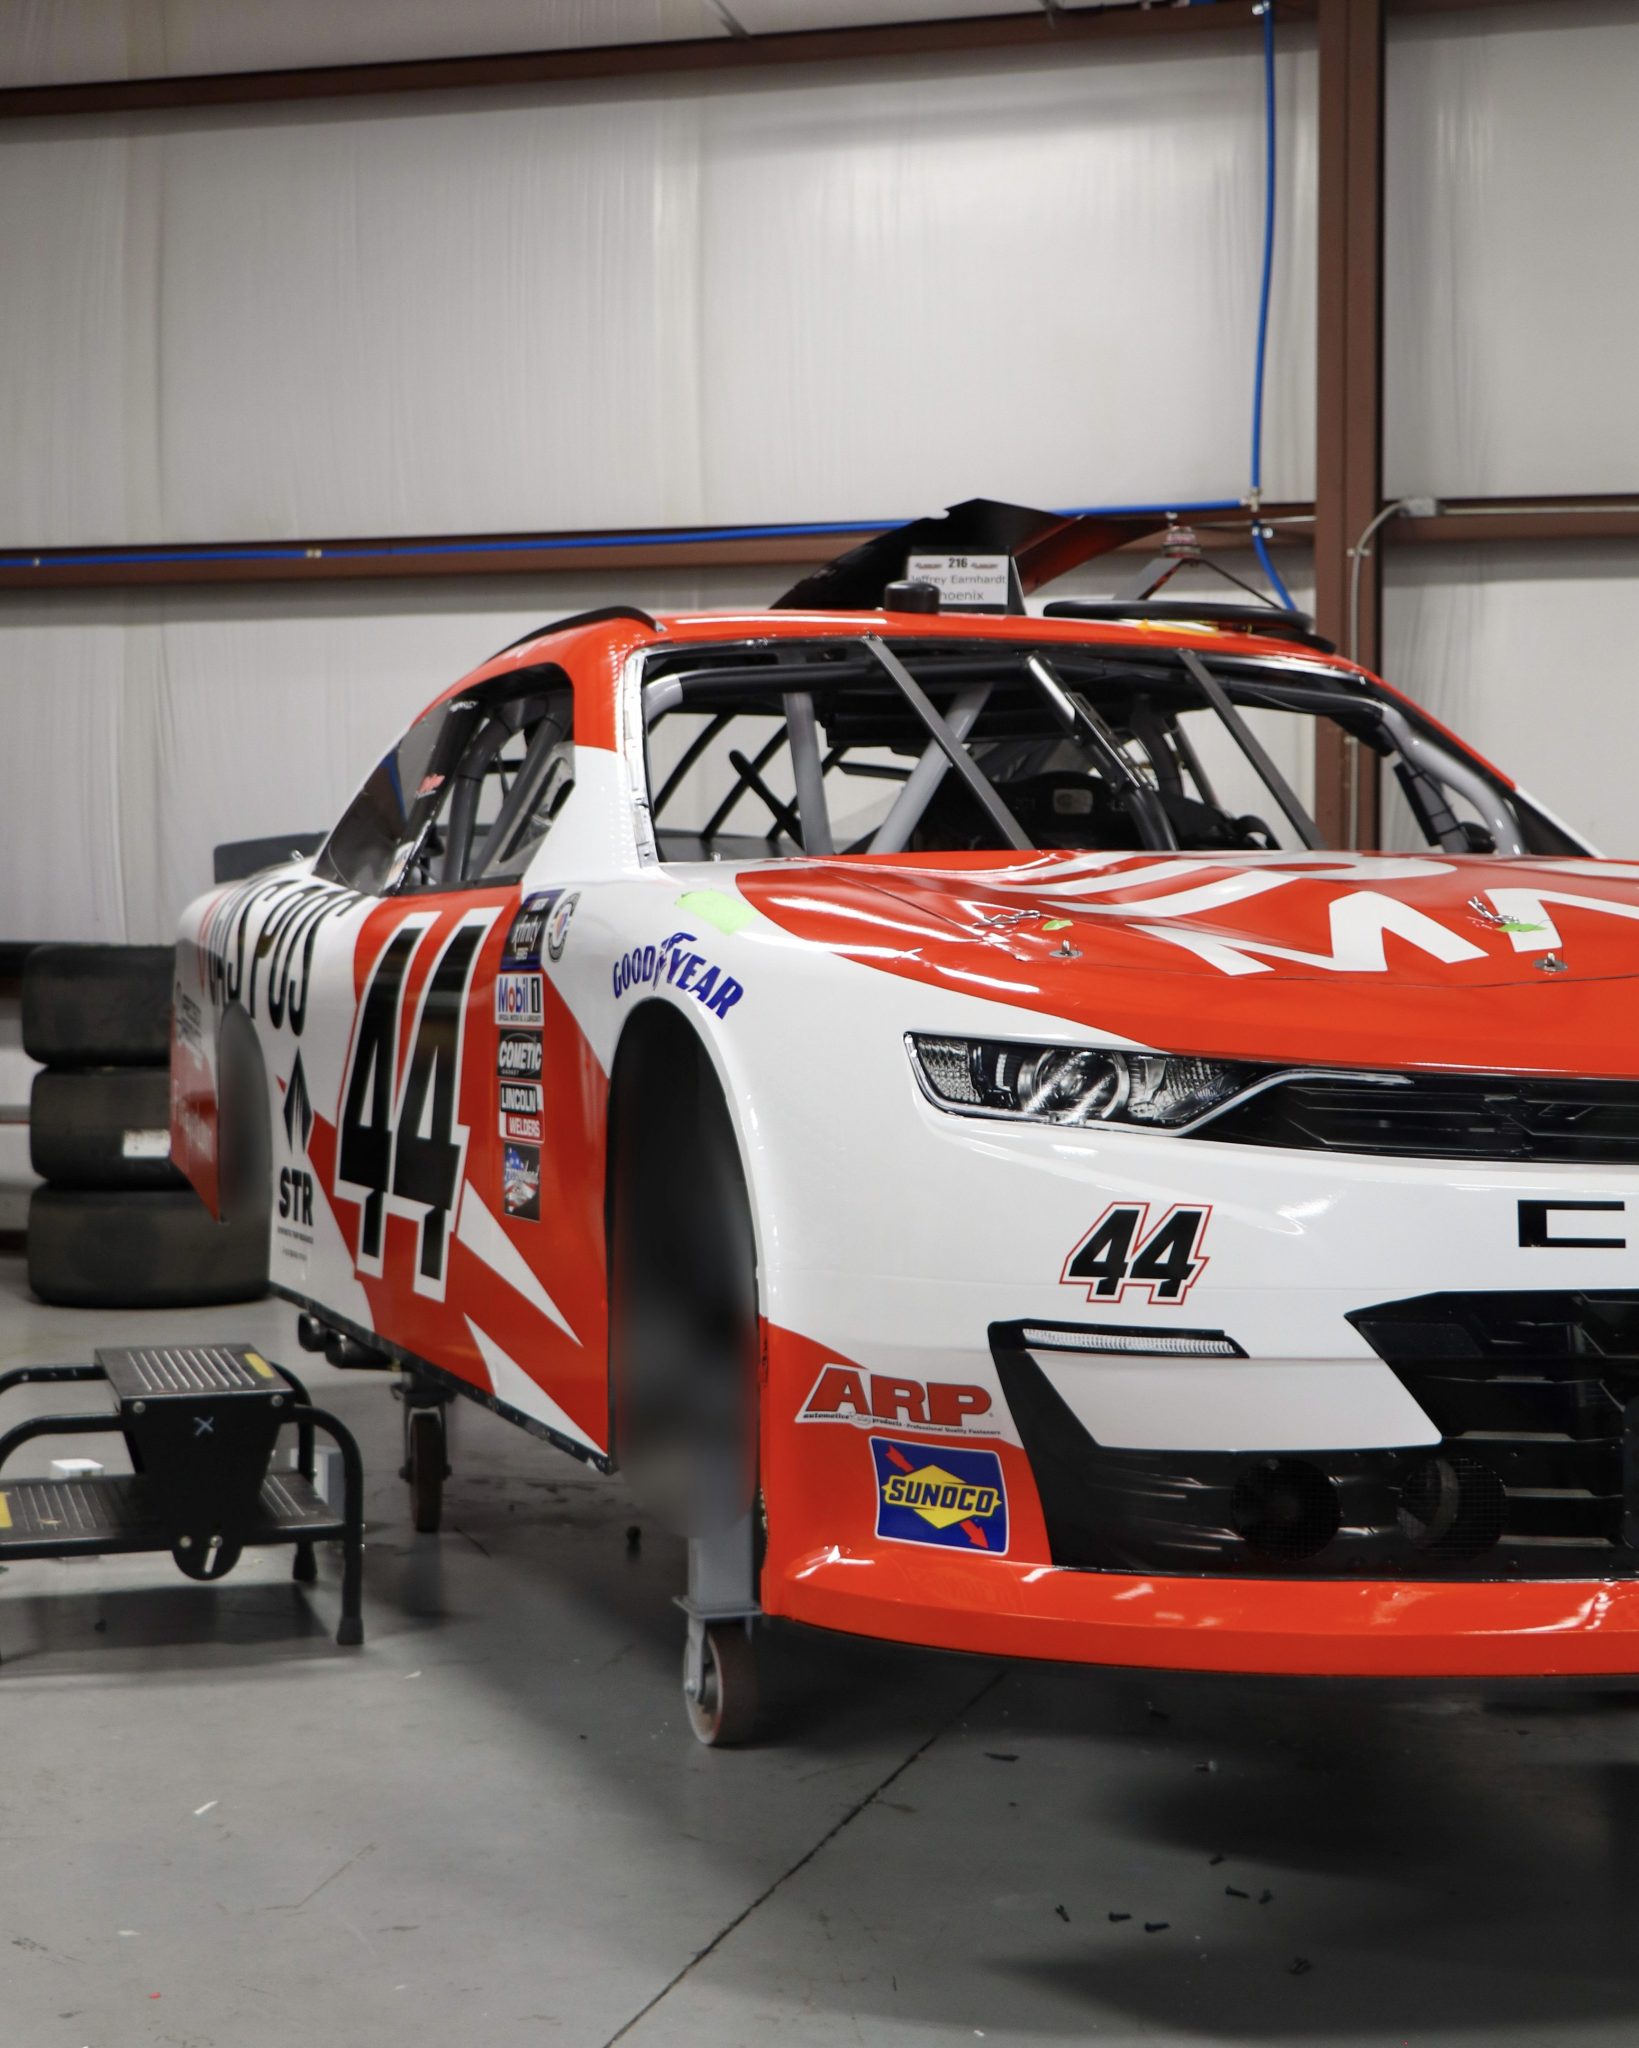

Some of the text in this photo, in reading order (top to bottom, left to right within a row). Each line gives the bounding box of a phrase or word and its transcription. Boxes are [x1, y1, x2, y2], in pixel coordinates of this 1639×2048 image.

[948, 557, 968, 568] 216
[951, 574, 1006, 584] Earnhardt
[940, 590, 985, 601] hoenix
[498, 976, 541, 1013] Mobil 1
[613, 942, 744, 1020] GOODYEAR
[499, 1040, 542, 1069] COMETIC
[335, 908, 502, 1301] 44
[501, 1086, 536, 1112] LINCOLN
[509, 1117, 540, 1137] WELDERS
[278, 1165, 314, 1227] STR
[1518, 1200, 1626, 1249] C
[1060, 1202, 1213, 1305] 44
[805, 1367, 993, 1427] ARP
[888, 1479, 995, 1513] SUNOCO
